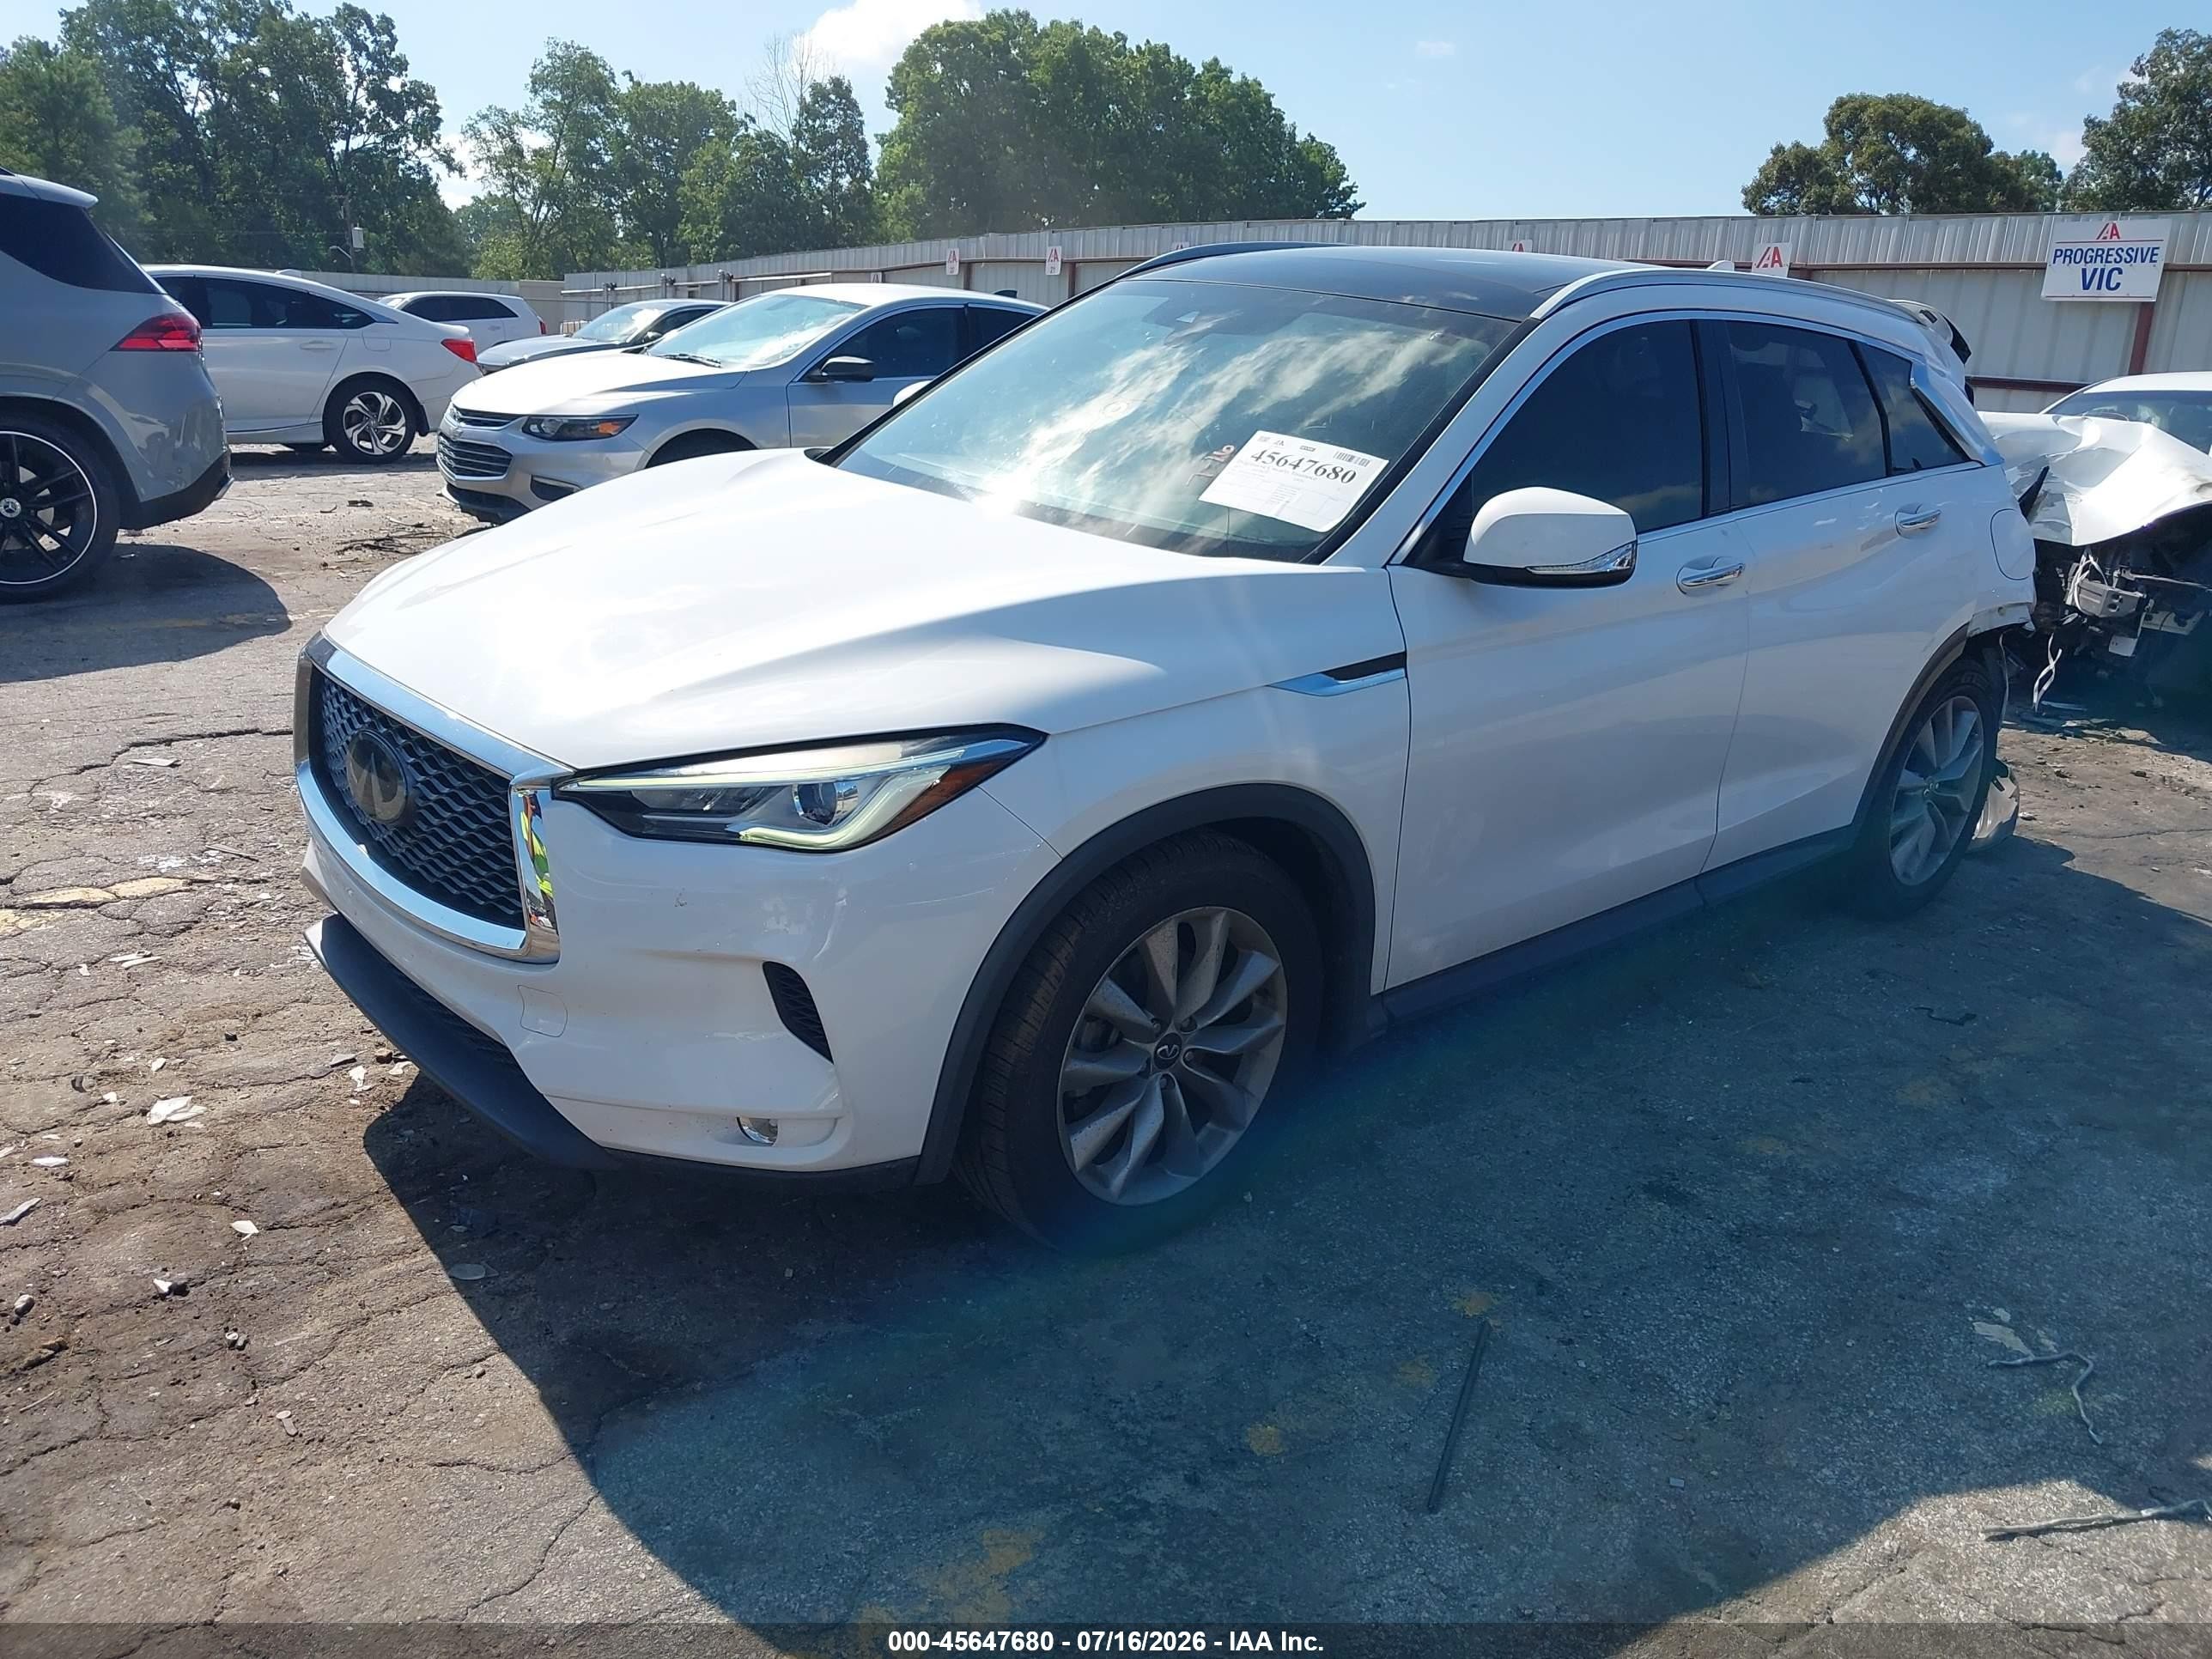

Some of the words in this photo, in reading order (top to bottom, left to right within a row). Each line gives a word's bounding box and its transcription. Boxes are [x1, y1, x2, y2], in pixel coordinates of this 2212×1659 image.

[2052, 246, 2160, 264] PROGRESSIVE
[2081, 266, 2124, 291] VIC
[1250, 449, 1357, 484] 45647680
